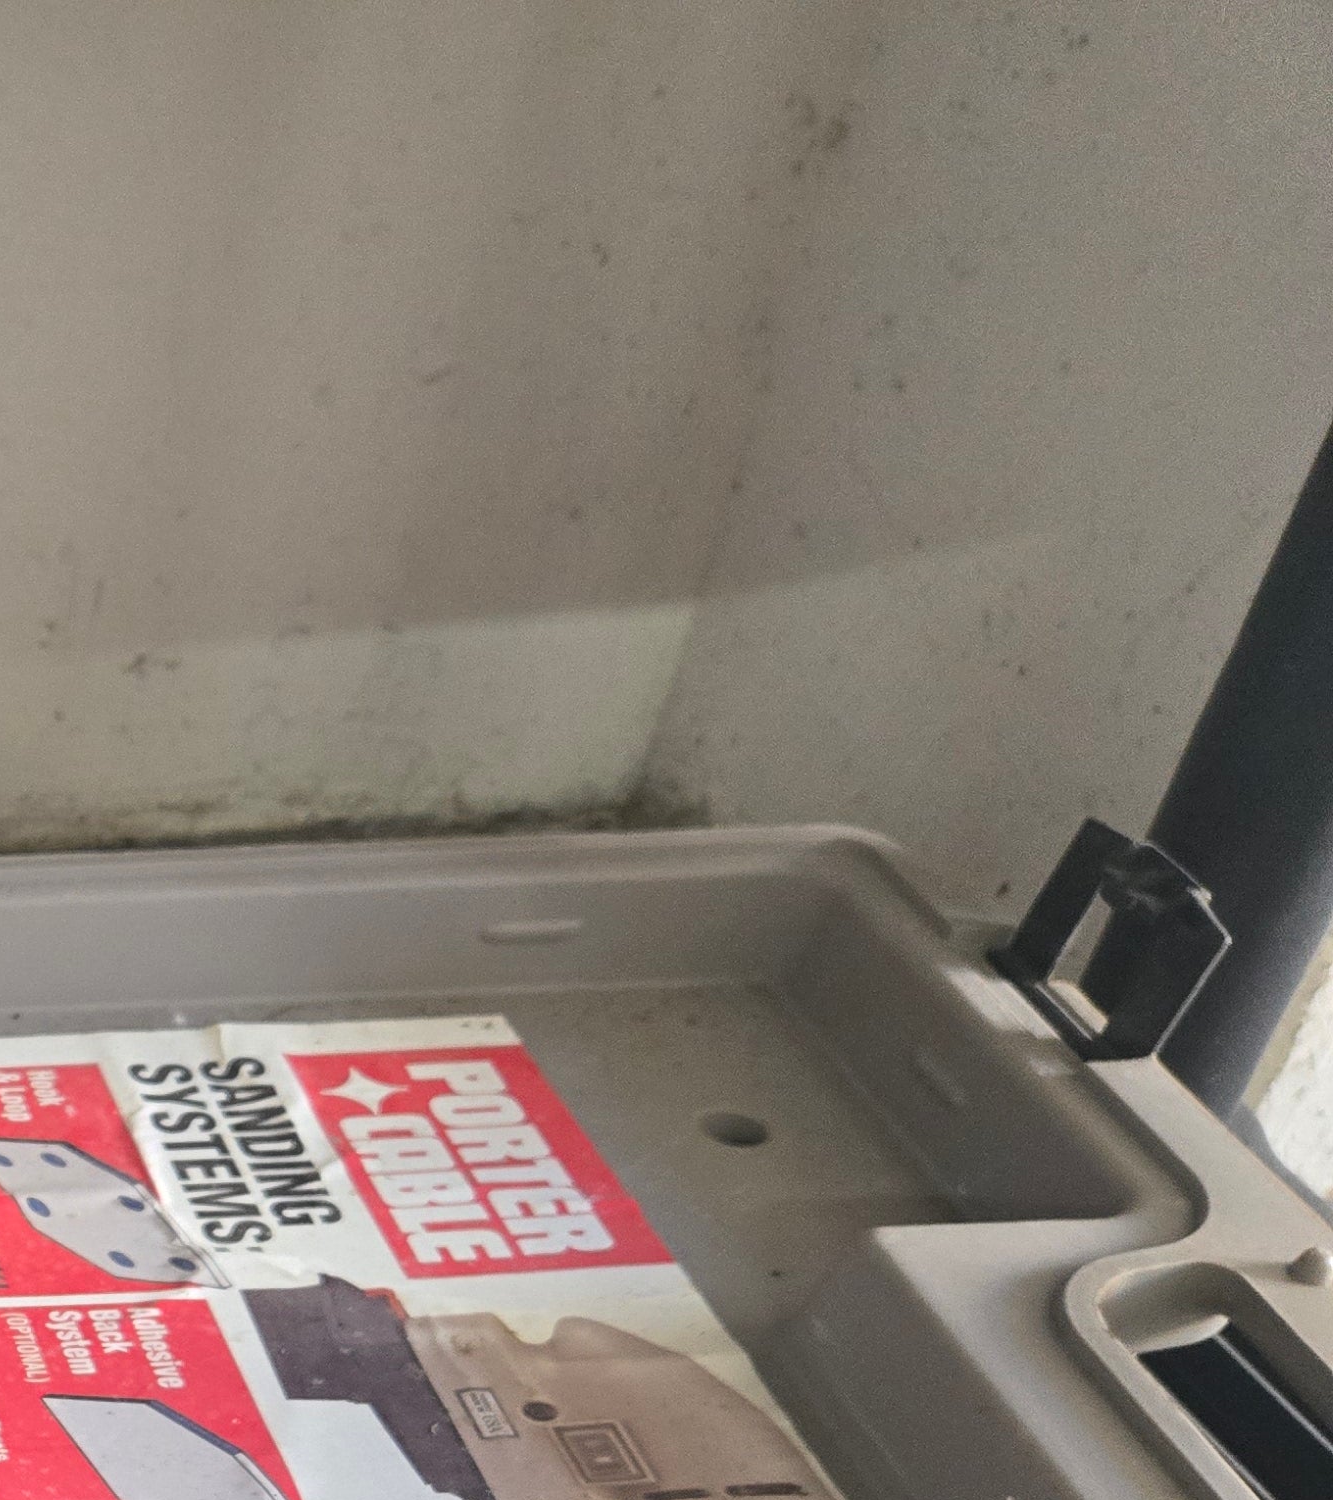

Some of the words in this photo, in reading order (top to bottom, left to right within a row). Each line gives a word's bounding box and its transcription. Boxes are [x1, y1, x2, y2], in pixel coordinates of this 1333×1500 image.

[27, 1071, 61, 1107] Hook
[129, 1064, 274, 1253] SYSTEMS:
[200, 1057, 342, 1226] SANDING
[406, 1061, 616, 1255] PORTER
[338, 1114, 511, 1263] CABLE
[0, 1312, 52, 1383] (OPTIONAL)
[40, 1310, 104, 1375] System
[86, 1308, 136, 1353] Back
[128, 1307, 185, 1389] Adhesive
